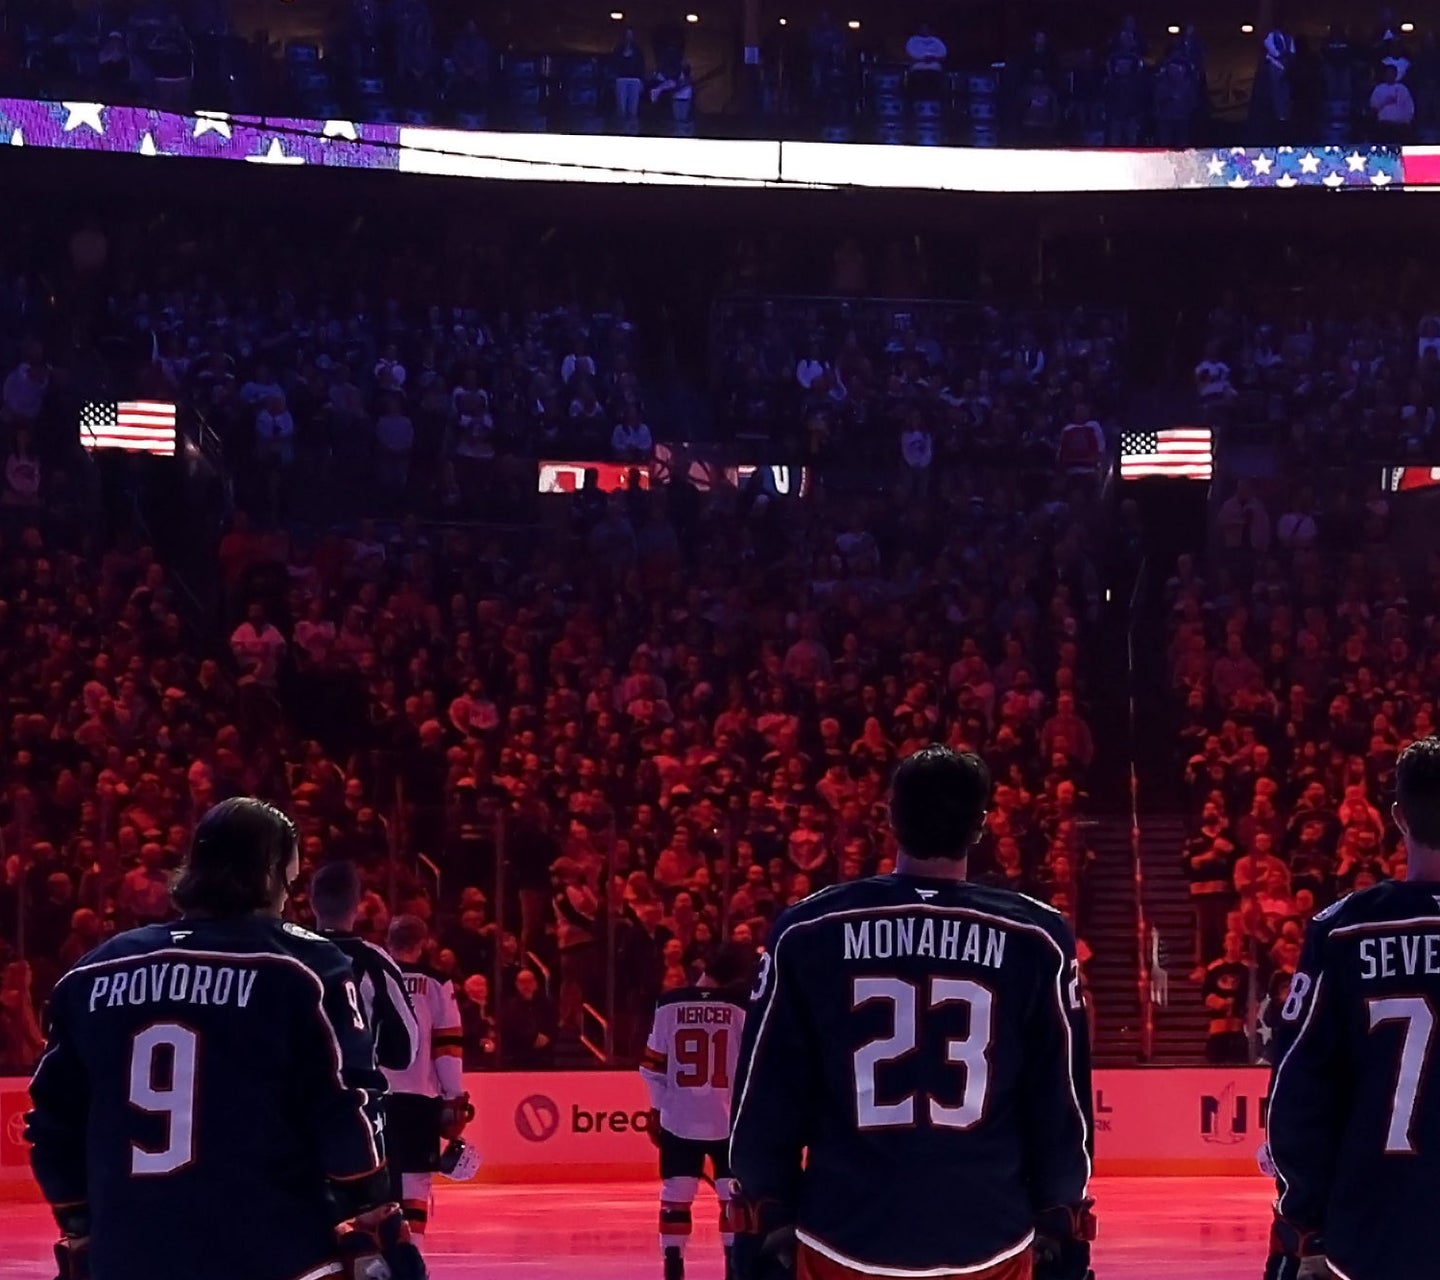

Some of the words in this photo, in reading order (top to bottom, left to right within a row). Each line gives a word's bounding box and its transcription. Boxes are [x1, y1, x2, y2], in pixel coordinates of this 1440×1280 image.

[843, 918, 1006, 969] MONAHAN
[89, 967, 258, 1014] PROVOROV
[677, 1007, 732, 1024] MERCER
[675, 1028, 729, 1089] 91
[852, 976, 994, 1130] 23
[128, 1023, 201, 1177] 9
[572, 1104, 652, 1133] brea
